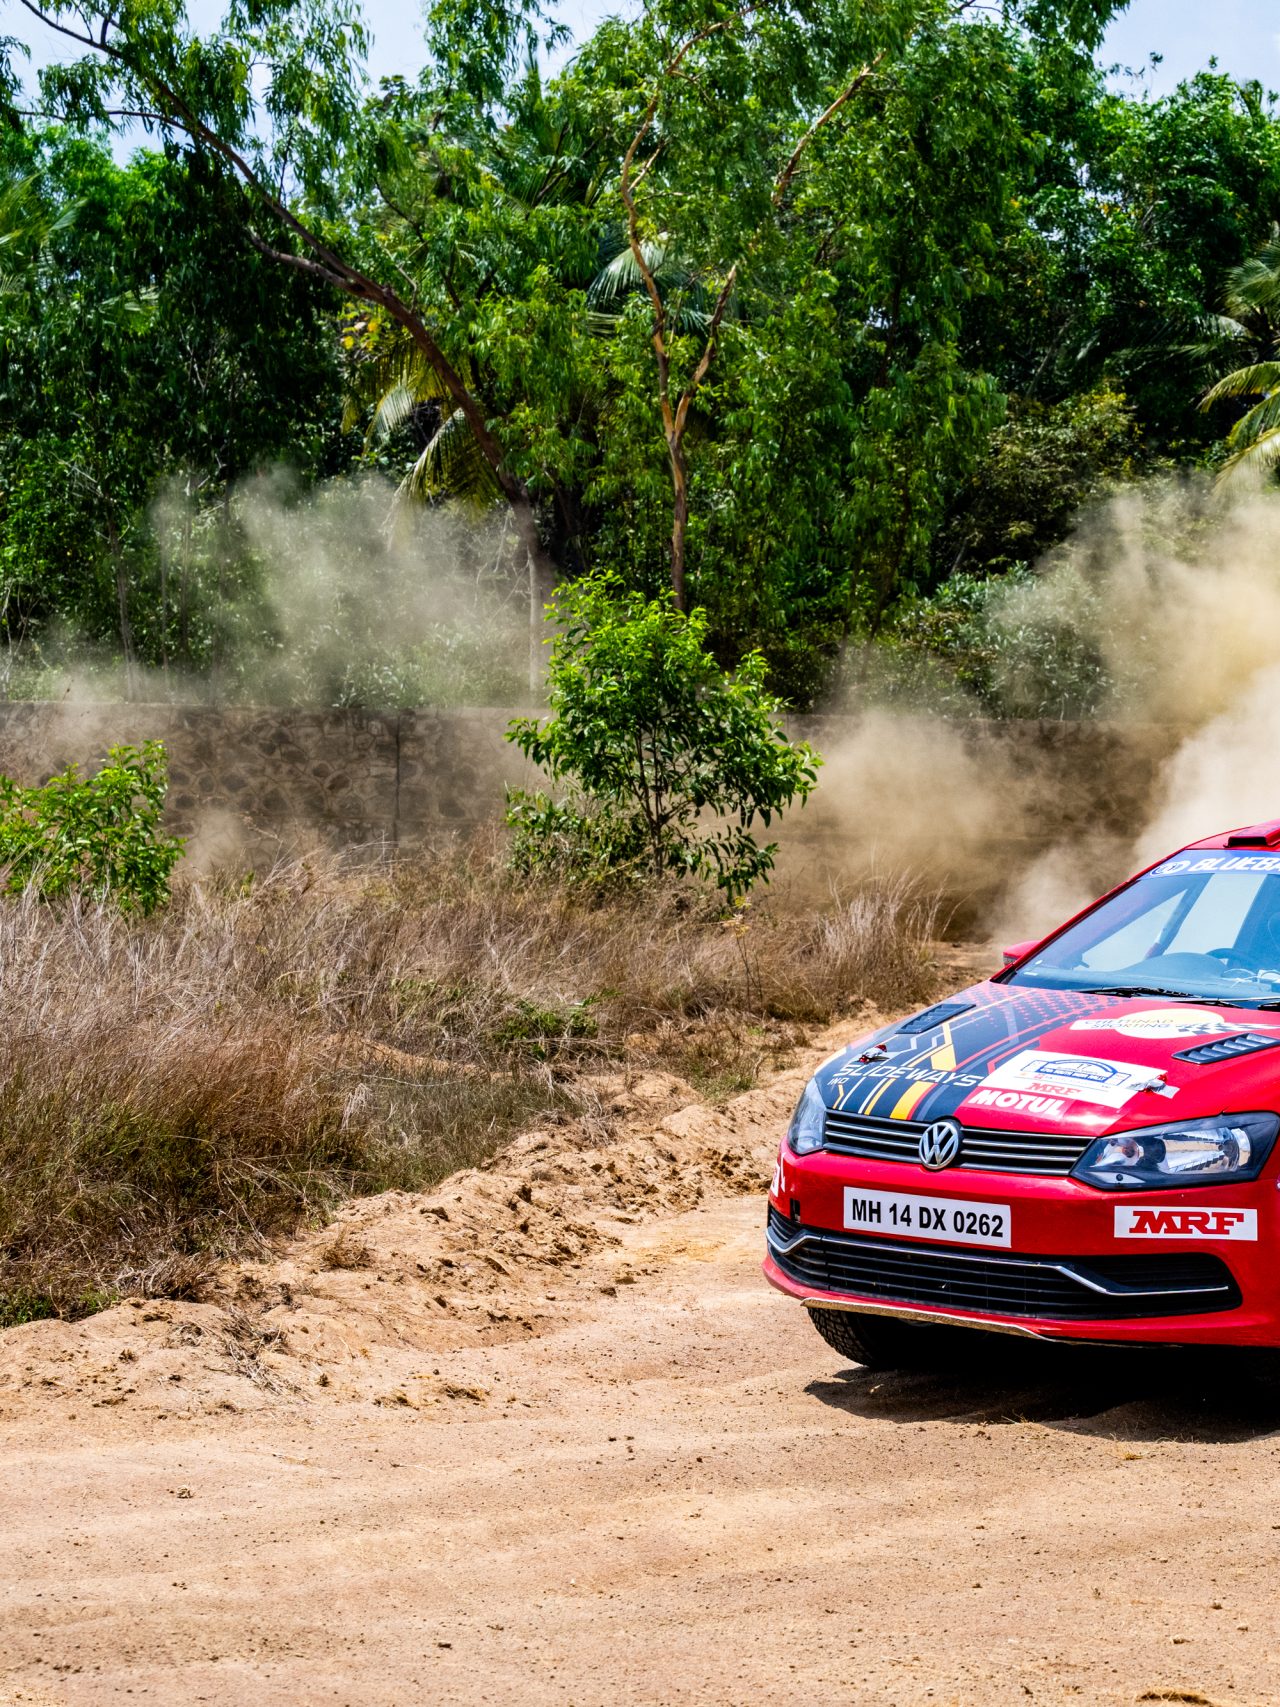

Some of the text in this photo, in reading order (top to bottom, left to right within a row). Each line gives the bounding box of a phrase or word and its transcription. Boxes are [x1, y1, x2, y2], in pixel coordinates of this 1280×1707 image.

[832, 1064, 985, 1087] SLIDEWAYS
[1025, 1082, 1082, 1095] MRF
[968, 1089, 1067, 1116] MOTUL
[852, 1198, 1004, 1238] MH 14 DX 0262
[1129, 1210, 1244, 1236] MRF
